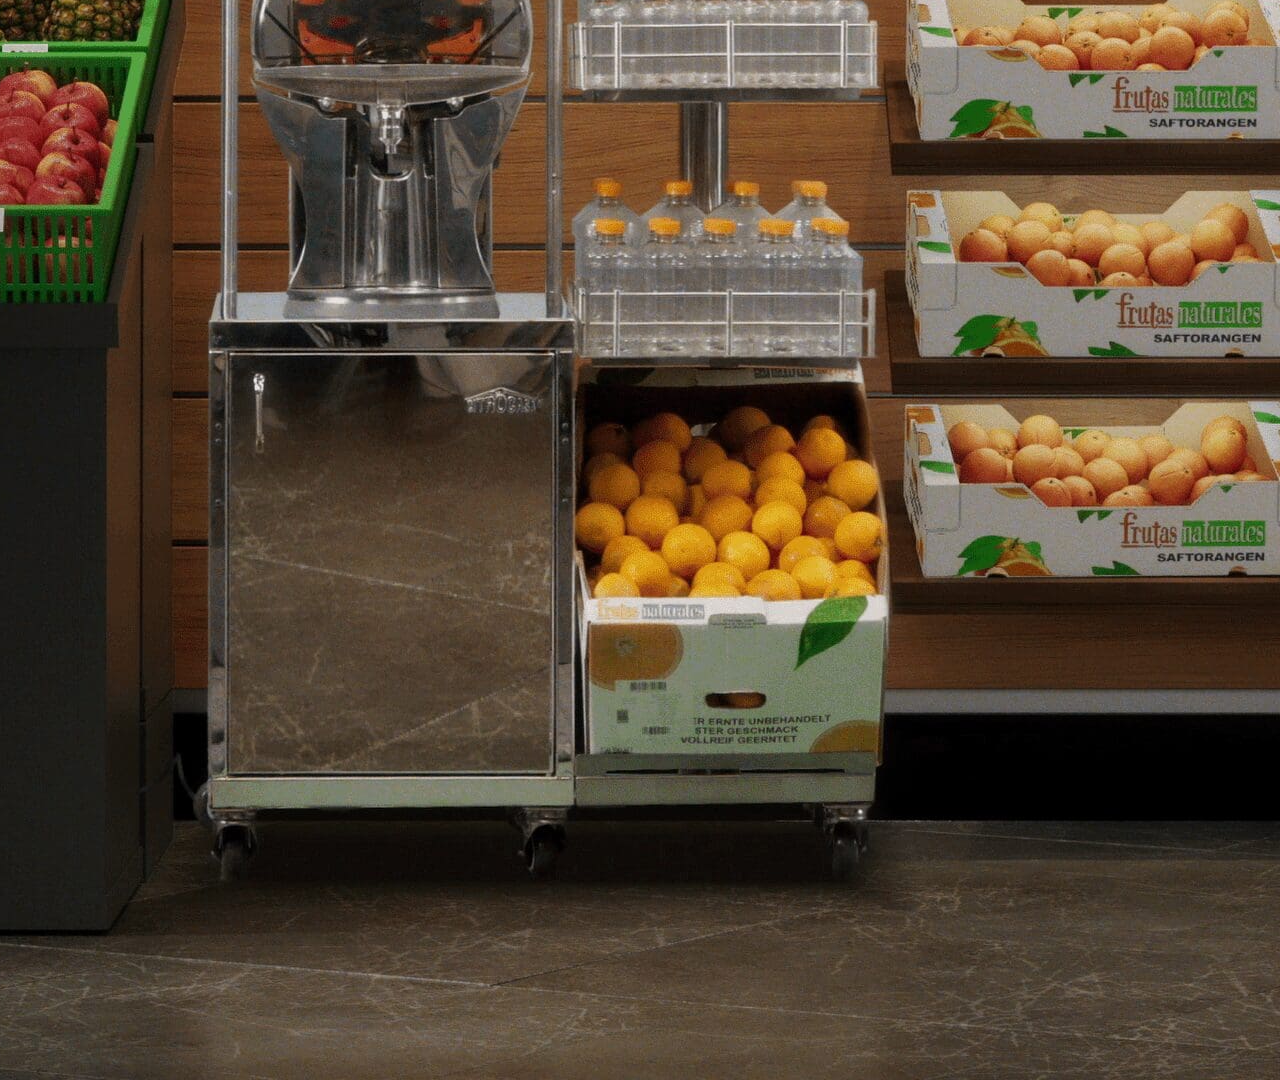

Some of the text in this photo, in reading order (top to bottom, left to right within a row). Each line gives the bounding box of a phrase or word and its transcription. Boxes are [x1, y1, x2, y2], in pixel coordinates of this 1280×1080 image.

[1112, 77, 1258, 113] frutas naturales
[1149, 119, 1257, 128] SAFTORANGEN
[1116, 293, 1262, 329] frutas naturales
[1154, 334, 1262, 344] SAFTORANGEN
[1120, 512, 1266, 548] frutas naturales
[1157, 553, 1265, 562] SAFTORANGEN
[708, 717, 745, 726] ERNTE
[749, 714, 831, 726] UNBEHANDELT
[727, 726, 799, 735] GESCHMACK
[681, 735, 797, 744] VOLLREIF GEERNTET
